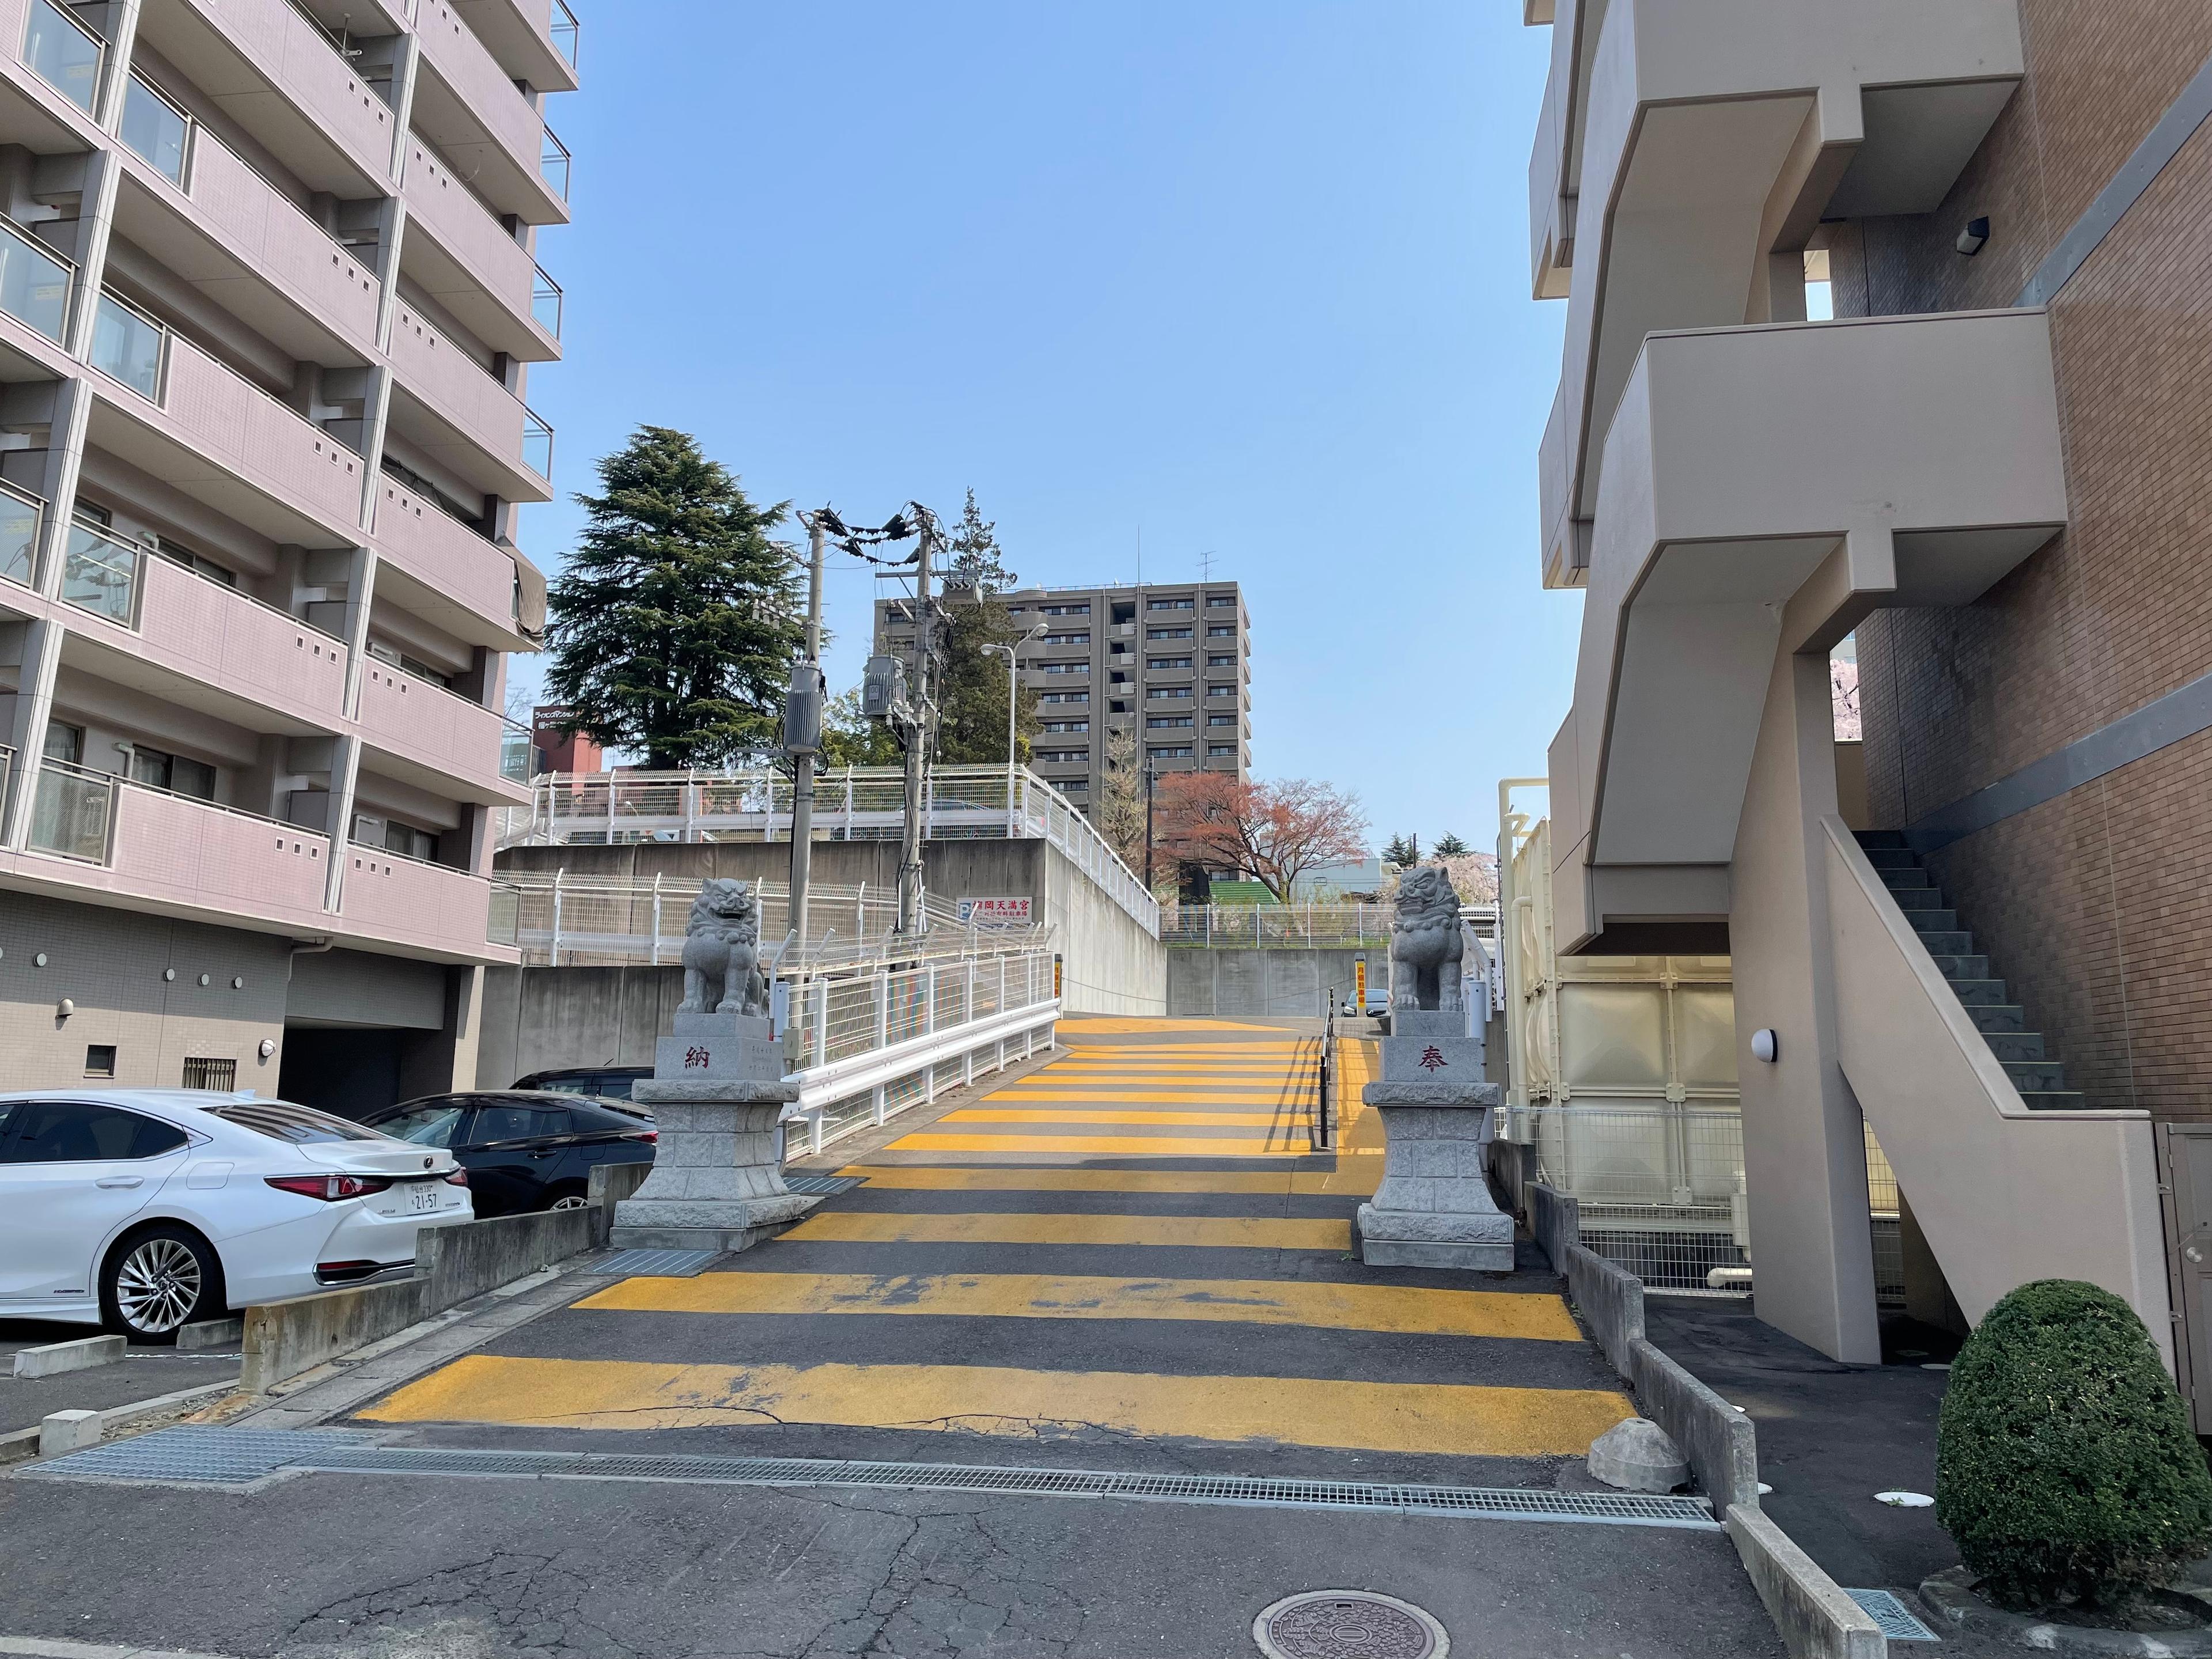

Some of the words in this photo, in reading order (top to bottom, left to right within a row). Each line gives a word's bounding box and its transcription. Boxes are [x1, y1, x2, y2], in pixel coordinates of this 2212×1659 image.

[535, 710, 575, 719] ライオンズマンション
[685, 1046, 710, 1069] 納
[1418, 1045, 1449, 1073] 奉
[416, 1194, 437, 1209] 21-57
